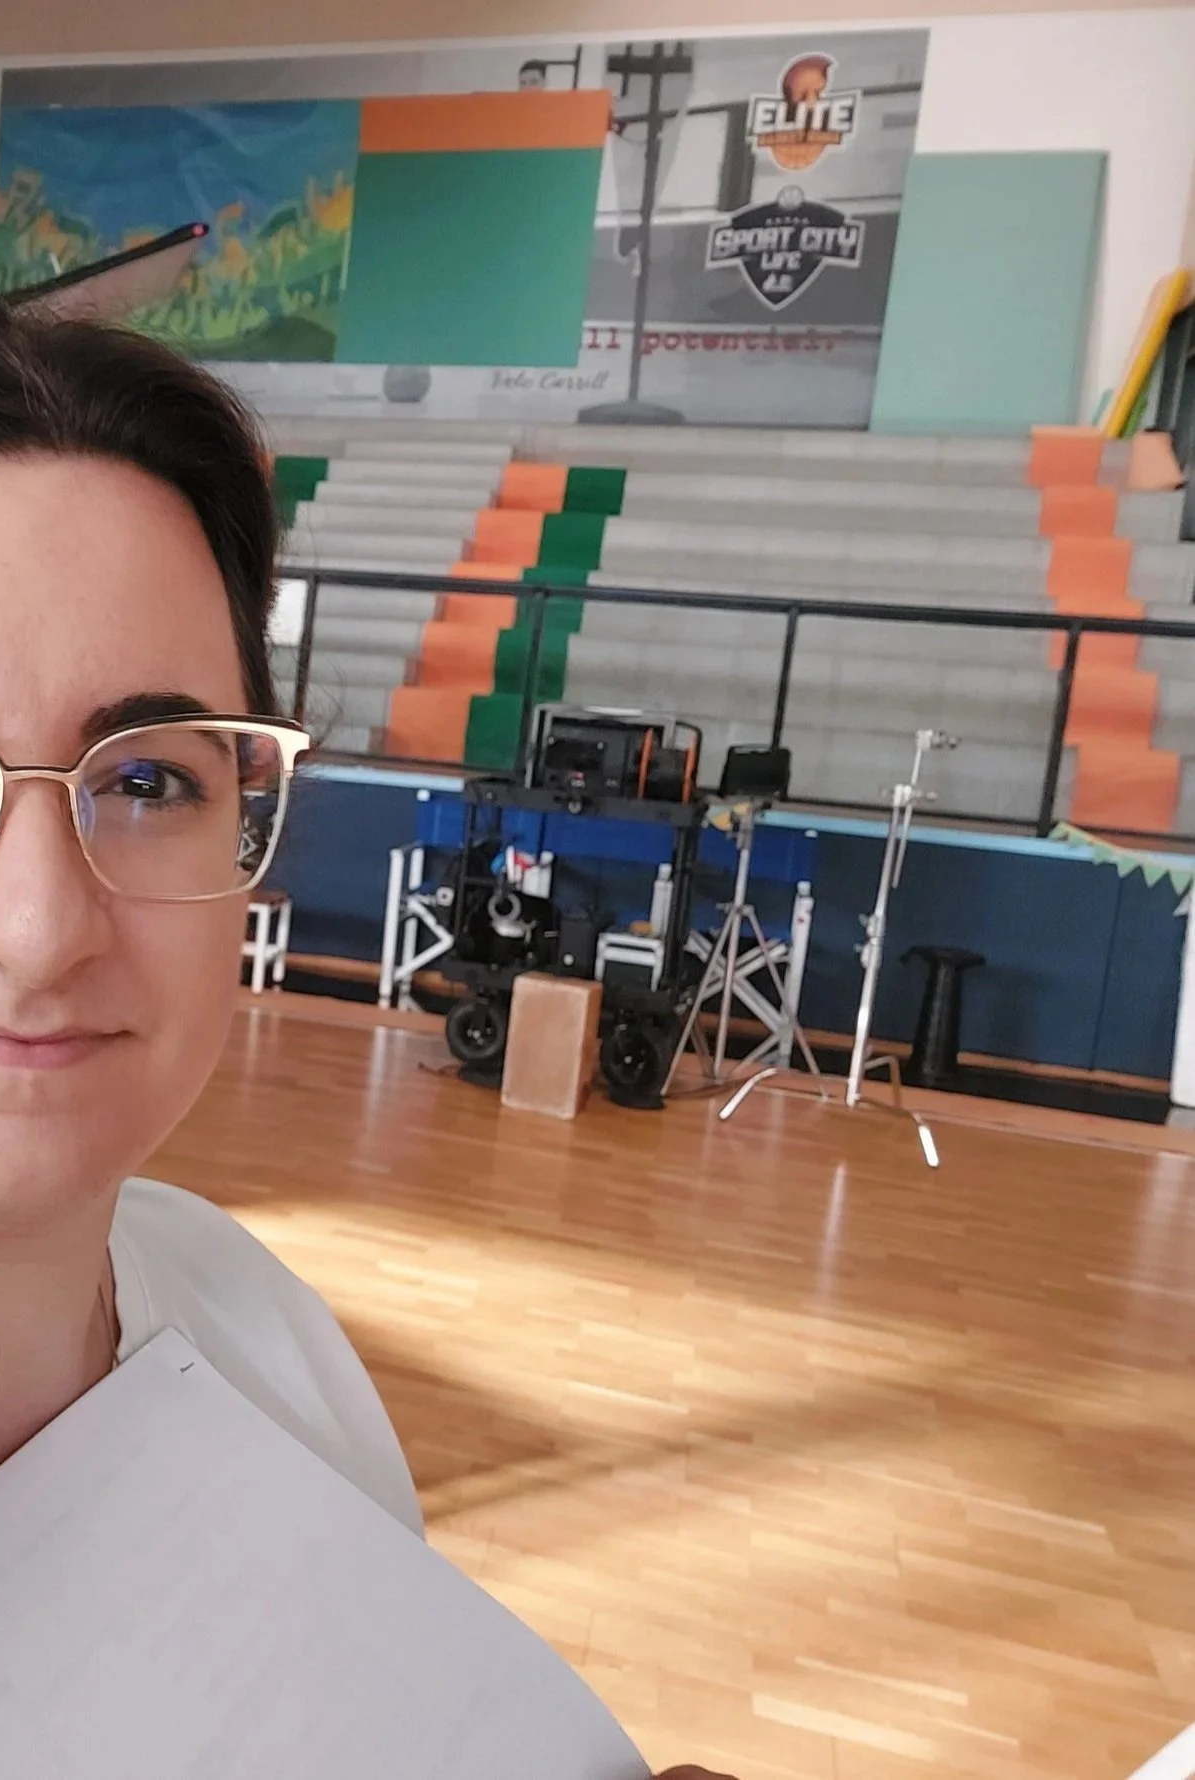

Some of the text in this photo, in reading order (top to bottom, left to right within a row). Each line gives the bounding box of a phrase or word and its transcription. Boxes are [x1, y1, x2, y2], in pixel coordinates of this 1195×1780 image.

[753, 98, 854, 133] ELITE
[713, 226, 859, 258] SPORT CITY
